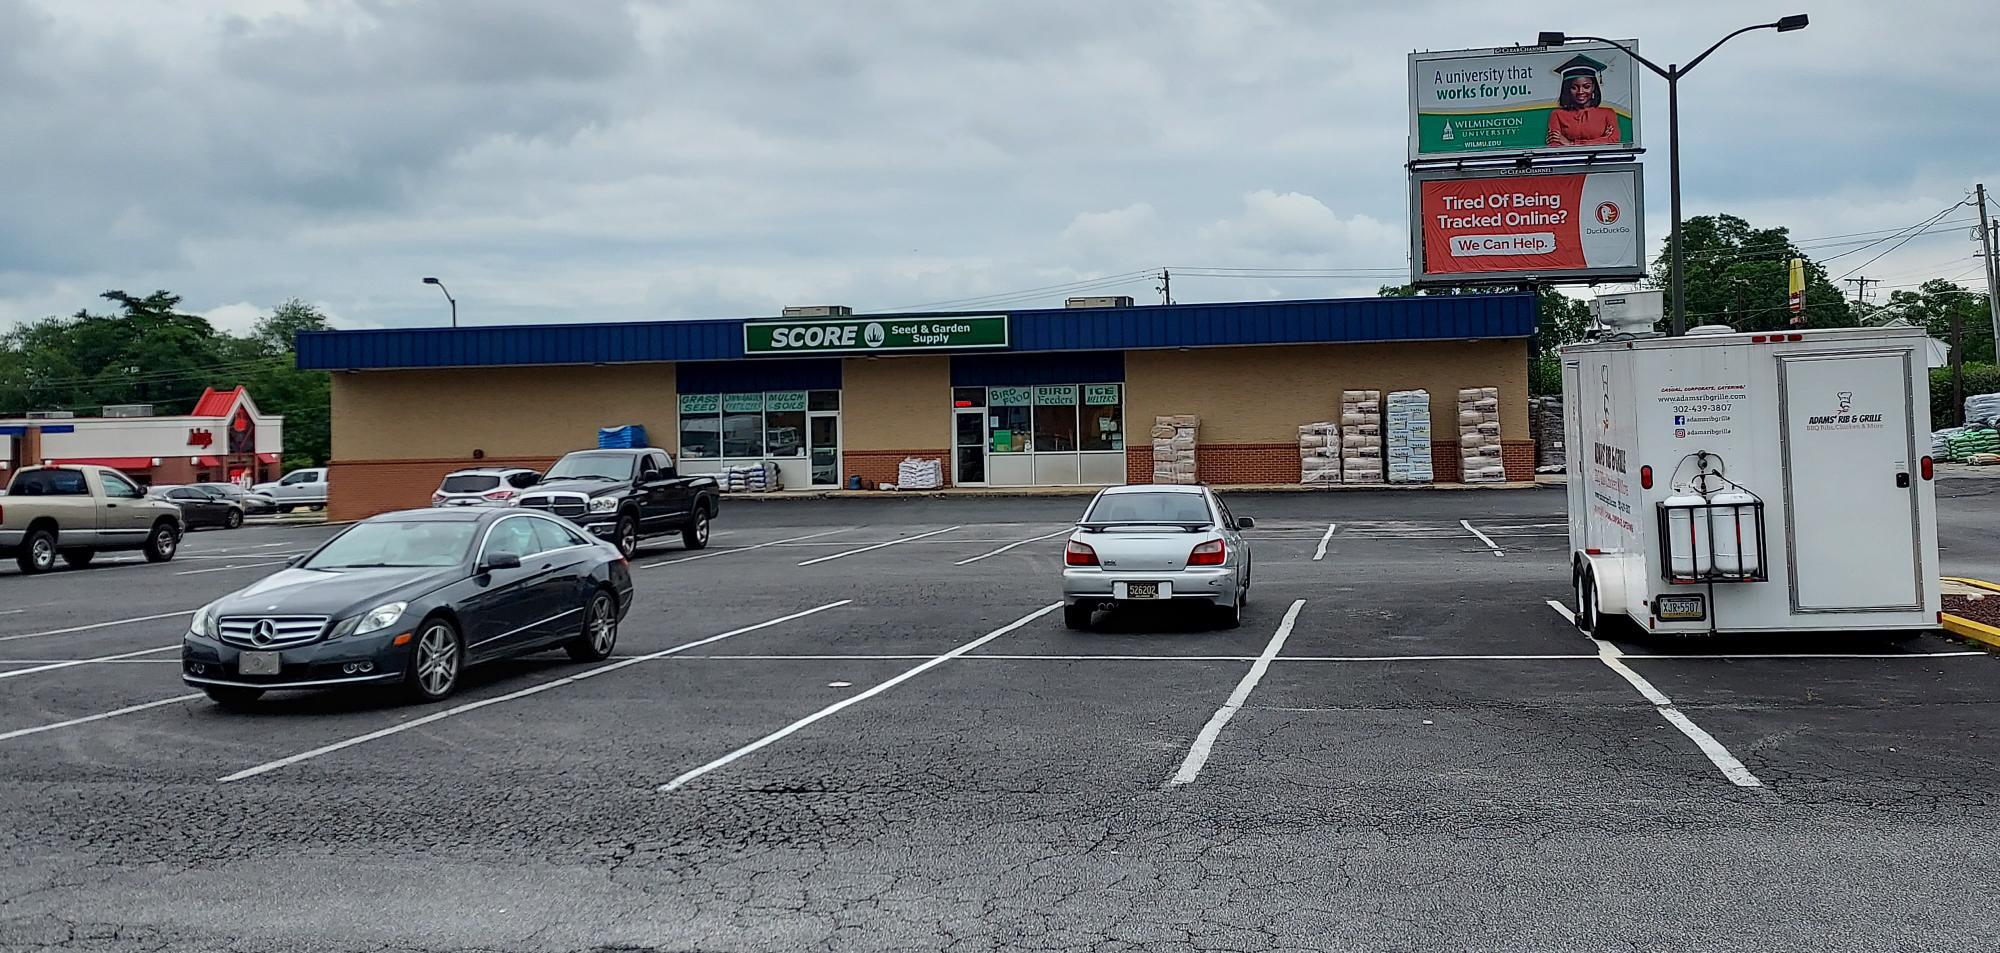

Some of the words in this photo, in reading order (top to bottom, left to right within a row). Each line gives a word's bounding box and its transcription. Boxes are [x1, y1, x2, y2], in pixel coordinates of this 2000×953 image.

[1435, 70, 1442, 84] A
[1446, 66, 1504, 84] university
[1507, 65, 1532, 80] that
[1437, 86, 1477, 100] works
[1480, 84, 1501, 98] for
[1502, 85, 1532, 100] you.
[1455, 117, 1523, 128] WILMINGTON
[1462, 129, 1517, 137] UNIVERSITY
[1464, 140, 1502, 148] WILMU.EDU
[1442, 194, 1485, 210] Tired
[1487, 193, 1510, 209] Of
[1512, 191, 1561, 208] Being
[1437, 211, 1502, 229] Tracked
[1505, 210, 1568, 227] Online?
[1458, 239, 1480, 251] We
[1483, 238, 1510, 250] Can
[1513, 236, 1548, 251] Help.
[771, 325, 858, 348] SCORE
[892, 325, 918, 335] Seed
[921, 324, 929, 334] &
[932, 323, 970, 334] Garden
[912, 333, 950, 344] Supply
[991, 388, 1016, 401] BIRD
[1039, 387, 1072, 395] BIRD
[1090, 387, 1114, 395] ICE
[682, 395, 720, 404] GRASS
[768, 393, 804, 402] MULCH
[1003, 391, 1030, 406] FOOD
[1038, 395, 1073, 405] Feeders
[1657, 393, 1746, 403] www.adamsribgrille.com
[684, 403, 717, 412] SEED
[774, 402, 804, 410] SOILS
[1673, 403, 1732, 413] 302-439-3807
[1838, 415, 1850, 423] RIB
[1851, 414, 1857, 423] &
[1859, 413, 1883, 422] GRILLE
[1129, 586, 1156, 595] 526202
